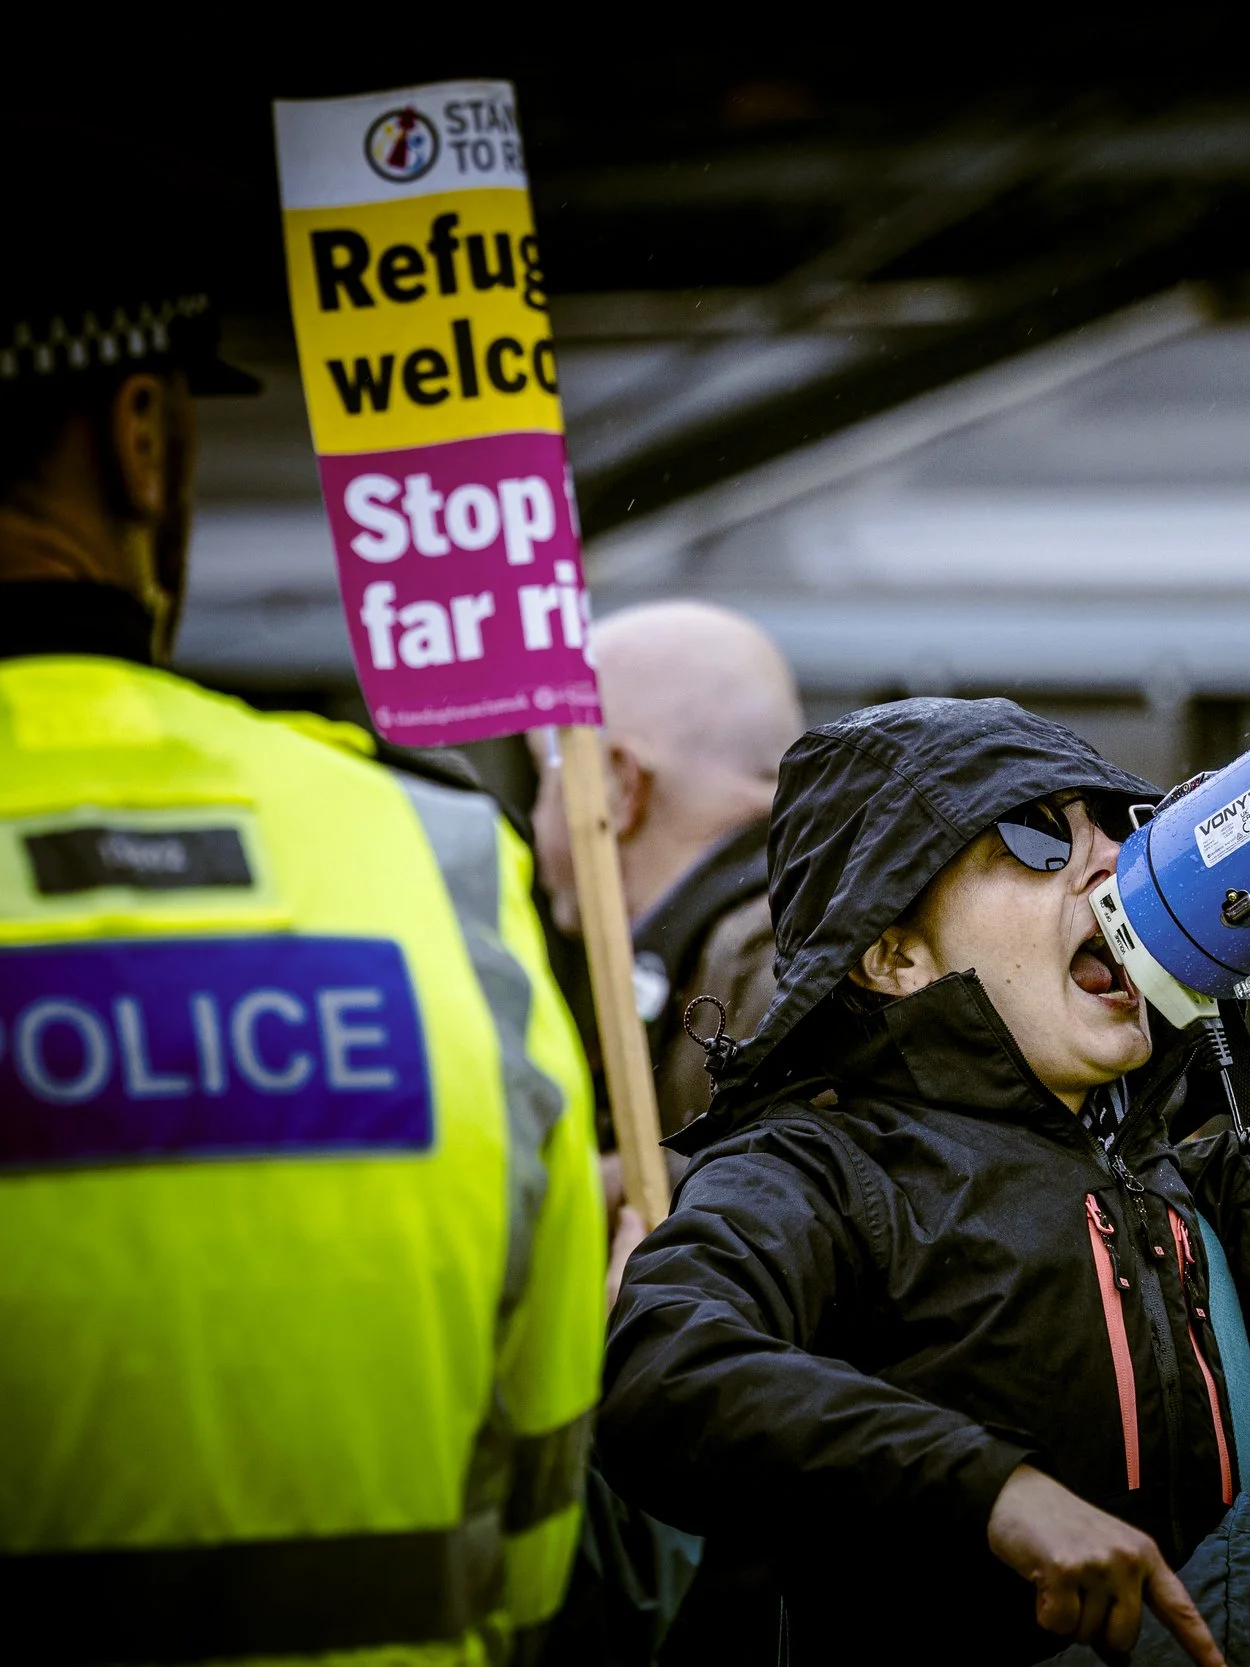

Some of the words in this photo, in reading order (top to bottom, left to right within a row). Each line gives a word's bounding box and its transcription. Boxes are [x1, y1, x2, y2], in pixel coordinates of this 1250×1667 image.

[448, 138, 497, 175] TO
[343, 472, 556, 566] Stop
[360, 580, 495, 670] far
[517, 559, 598, 669] ri
[0, 985, 397, 1103] OLICE
